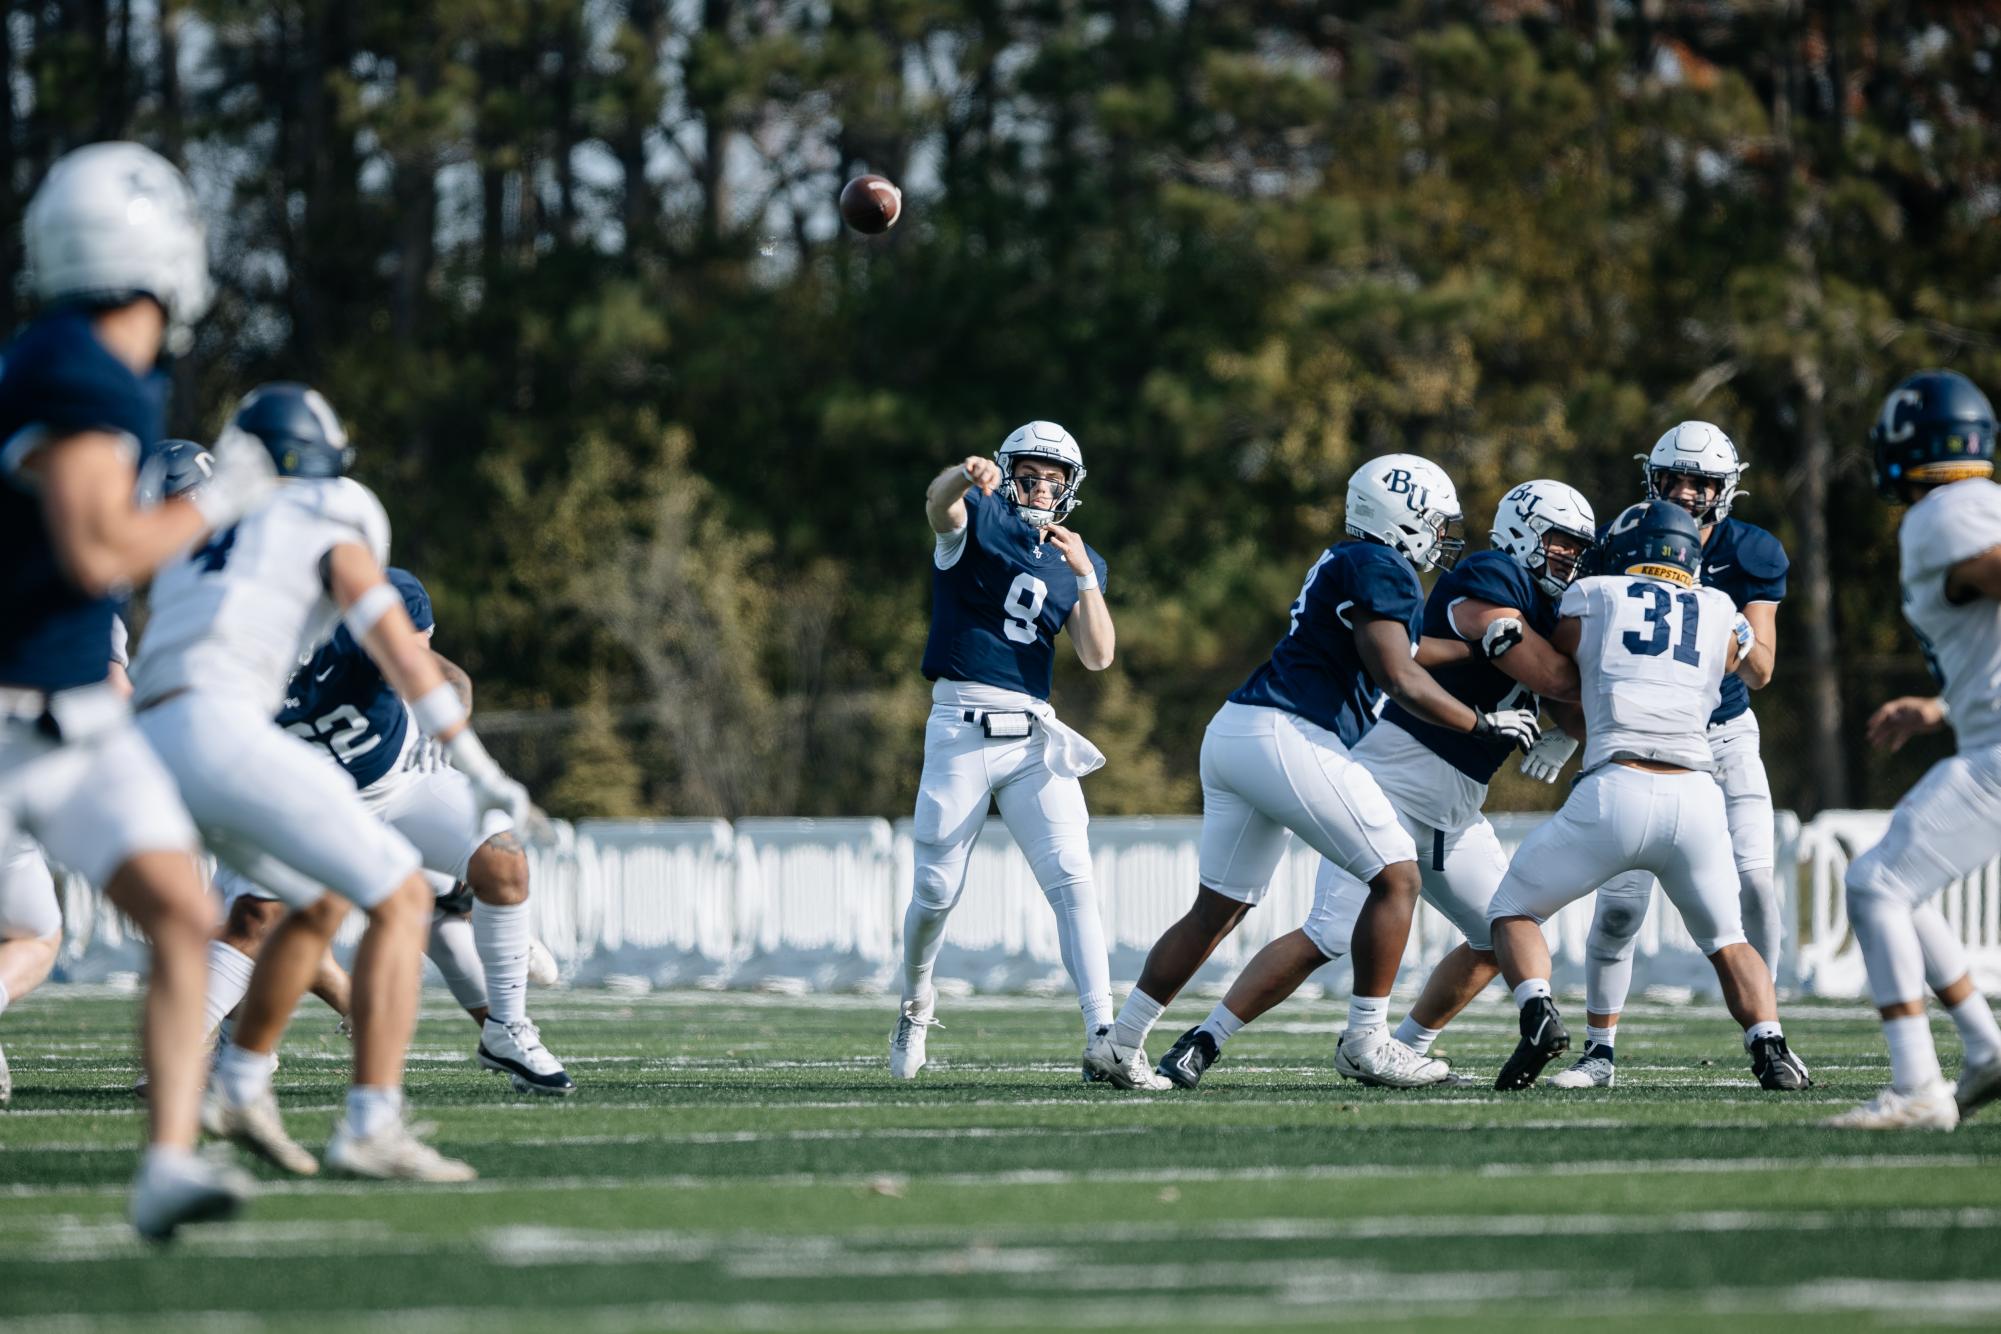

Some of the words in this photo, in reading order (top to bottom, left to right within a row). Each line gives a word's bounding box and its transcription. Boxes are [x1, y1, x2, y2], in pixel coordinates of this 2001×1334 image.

[1387, 468, 1431, 513] BU
[1003, 571, 1049, 645] 9
[1622, 582, 1700, 668] 31
